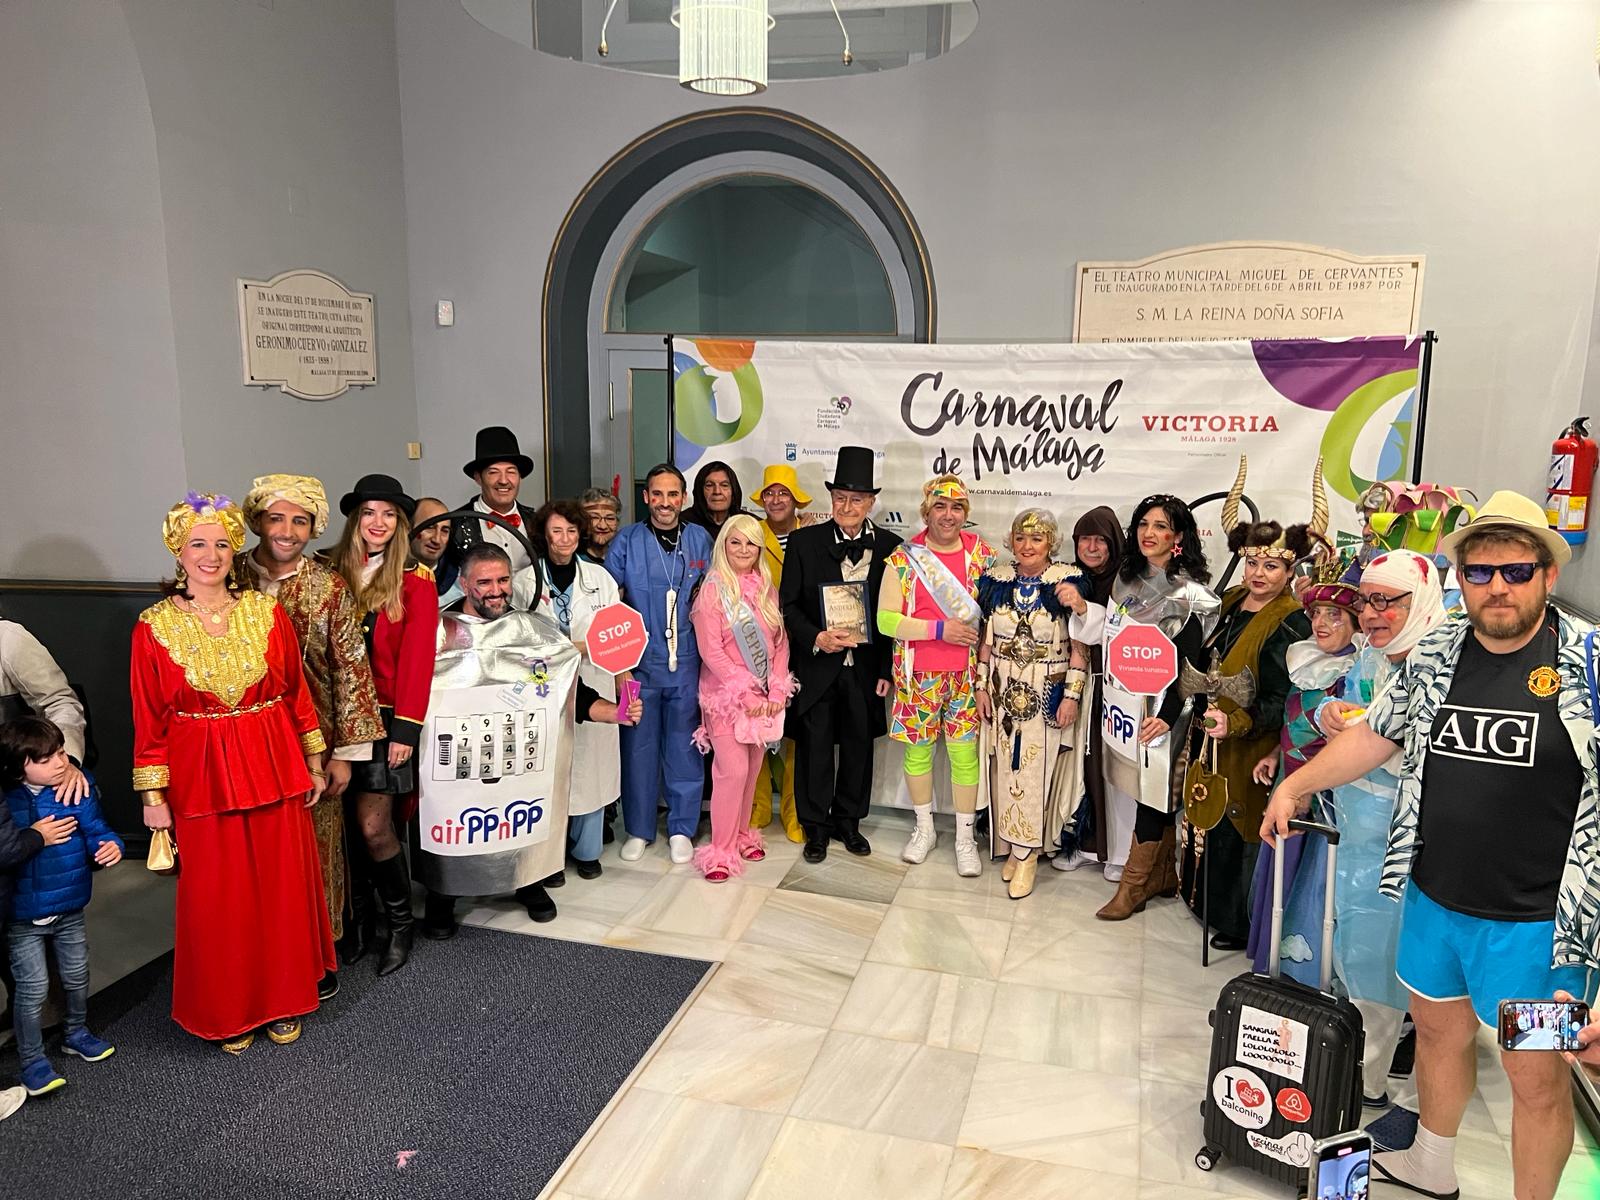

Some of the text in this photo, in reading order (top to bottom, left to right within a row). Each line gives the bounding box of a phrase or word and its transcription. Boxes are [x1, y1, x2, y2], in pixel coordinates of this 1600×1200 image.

[1094, 267, 1404, 282] EL TEATRO MUNICIPAL MIGUEL DE CERVANTES
[1094, 284, 1112, 292] FUE
[1116, 284, 1178, 292] INAUGURADO
[1289, 282, 1324, 291] ABRIL
[1328, 282, 1342, 290] DE
[1348, 281, 1372, 290] 1987
[1378, 280, 1401, 290] POR
[1136, 307, 1146, 321] S.
[1152, 307, 1168, 321] M.
[1174, 307, 1193, 321] LA
[1201, 307, 1246, 321] REINA
[1254, 304, 1295, 320] DOÑA
[298, 337, 326, 352] CUERVO
[331, 339, 368, 353] GONZALEZ
[900, 371, 1124, 437] Carnaval
[1142, 415, 1279, 432] VICTORIA
[802, 448, 838, 457] Ayuntamie
[932, 428, 1106, 481] de Málaga
[968, 488, 1052, 497] w.carnavaldemalaga.es
[598, 621, 632, 643] STOP
[1122, 646, 1162, 660] STOP
[461, 713, 535, 732] 6 9 2 7
[1102, 709, 1134, 744] PnPP
[462, 727, 534, 747] 7 0 3 8
[1432, 712, 1530, 757] AIG
[461, 756, 468, 765] 8
[506, 744, 512, 754] 4
[528, 746, 535, 756] 9
[484, 765, 490, 775] 2
[506, 761, 512, 770] 5
[526, 761, 533, 770] 0
[431, 804, 544, 845] airPPnPP
[1224, 1075, 1234, 1100] I
[1221, 1099, 1264, 1124] balconing
